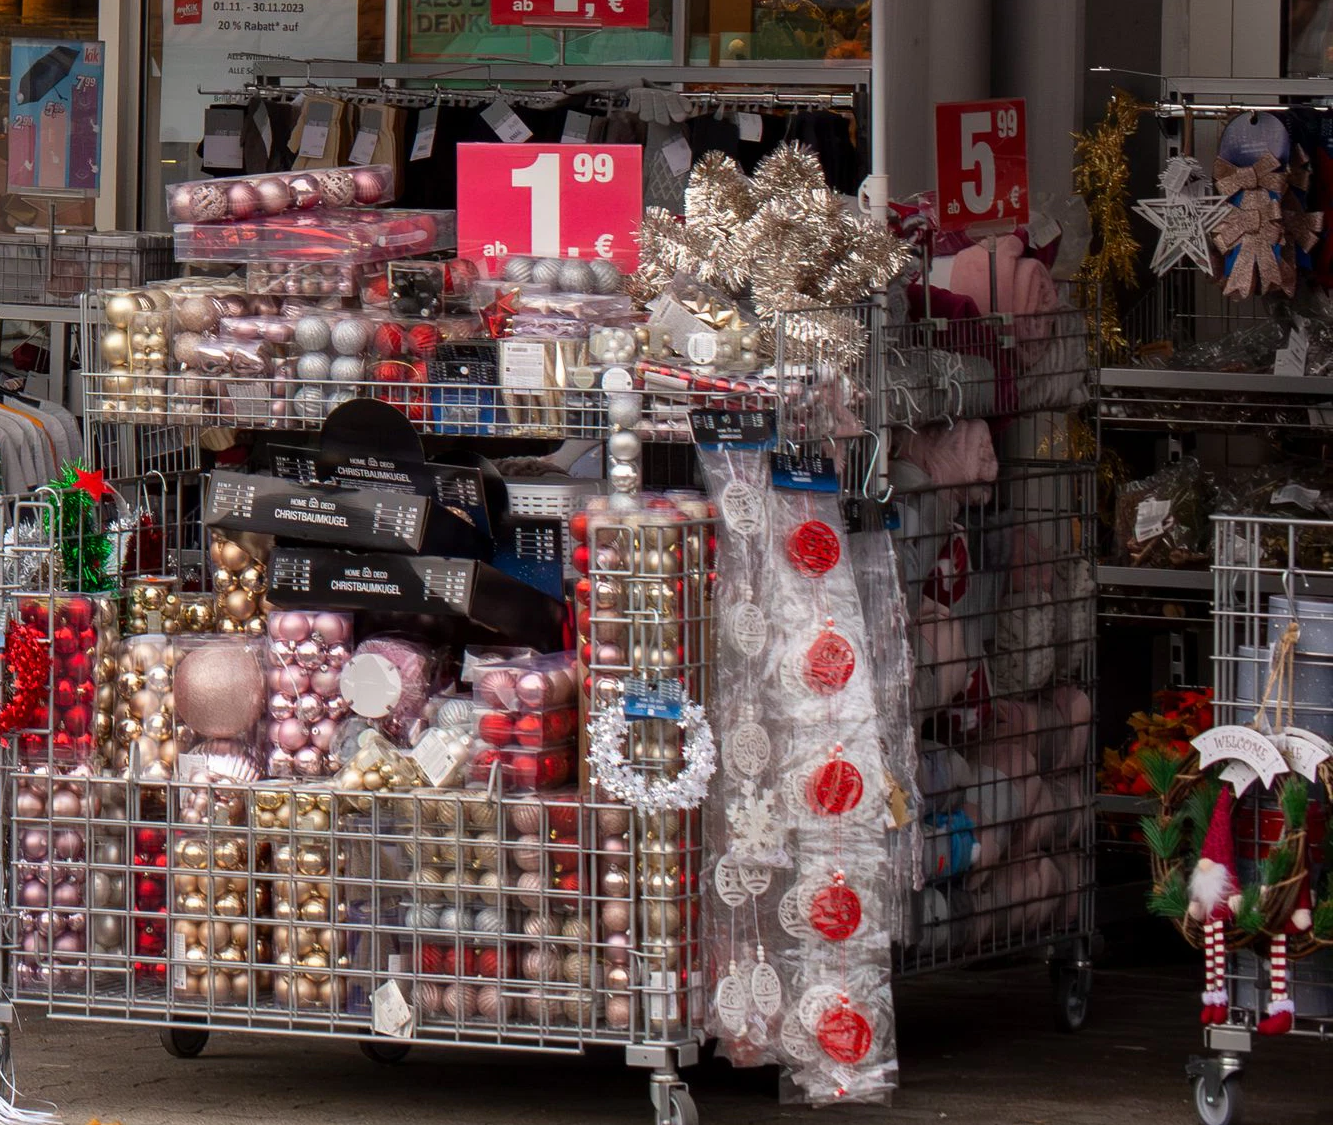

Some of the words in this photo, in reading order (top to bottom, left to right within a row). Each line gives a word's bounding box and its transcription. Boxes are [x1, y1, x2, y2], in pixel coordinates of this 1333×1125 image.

[213, 1, 244, 11] 01.11.
[253, 3, 304, 13] 30.11.2023
[218, 21, 230, 30] 20
[233, 21, 241, 31] %
[283, 22, 299, 32] auf
[85, 47, 99, 63] kik
[947, 199, 960, 214] ab
[483, 241, 508, 257] ab
[594, 234, 614, 258] €
[337, 466, 412, 483] CHRISTBAUMKUGEL
[290, 498, 307, 508] HOME
[320, 501, 336, 510] DECO
[274, 508, 349, 527] CHRISTBAUMKUGEL
[345, 569, 361, 578] HOME
[373, 571, 388, 580] DECO
[331, 580, 401, 595] CHRISTBAUMKUGEL
[1214, 735, 1269, 761] WELCOME
